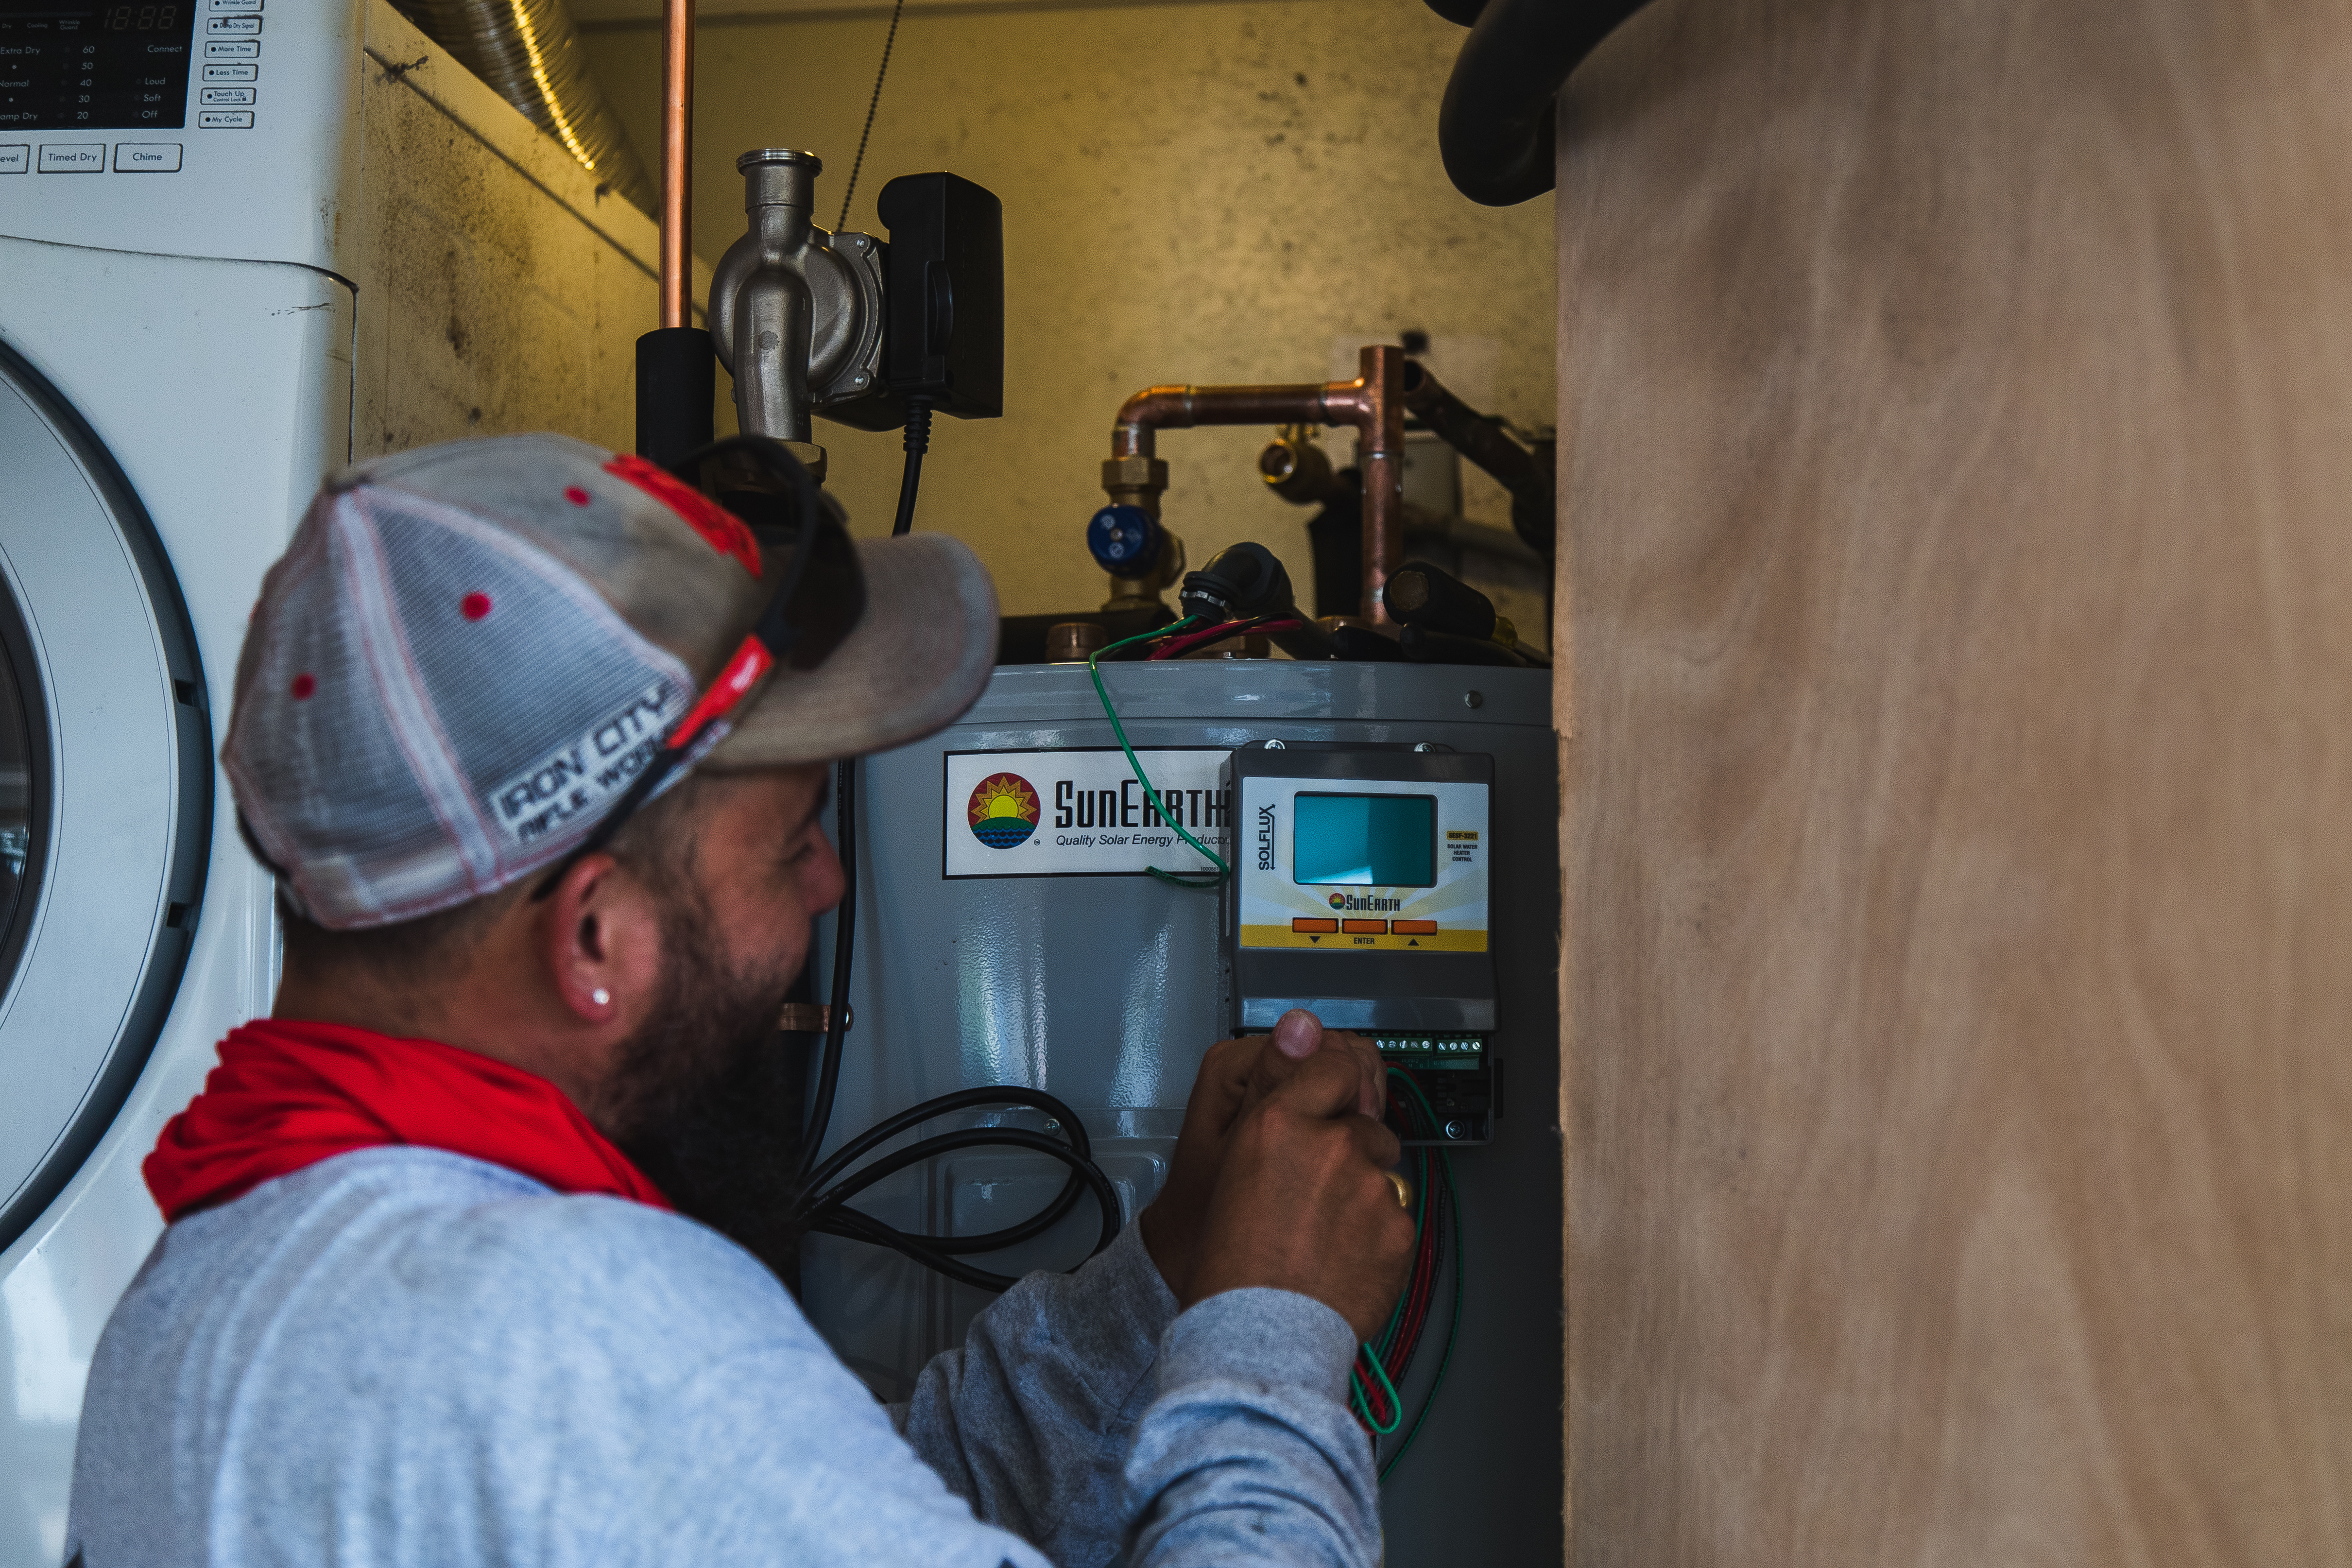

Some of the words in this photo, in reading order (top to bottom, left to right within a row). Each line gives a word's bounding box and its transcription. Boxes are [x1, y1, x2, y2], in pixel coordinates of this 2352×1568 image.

[25, 47, 40, 55] Dry
[23, 112, 38, 121] Dry
[142, 110, 158, 119] Off
[49, 153, 76, 161] Timed
[80, 153, 97, 162] Dry
[133, 152, 162, 161] Chime
[594, 679, 673, 757] CITY
[1056, 835, 1096, 847] Quality
[1099, 834, 1130, 845] Solar
[1132, 834, 1173, 847] Energy
[1258, 805, 1273, 871] SOLFLUX
